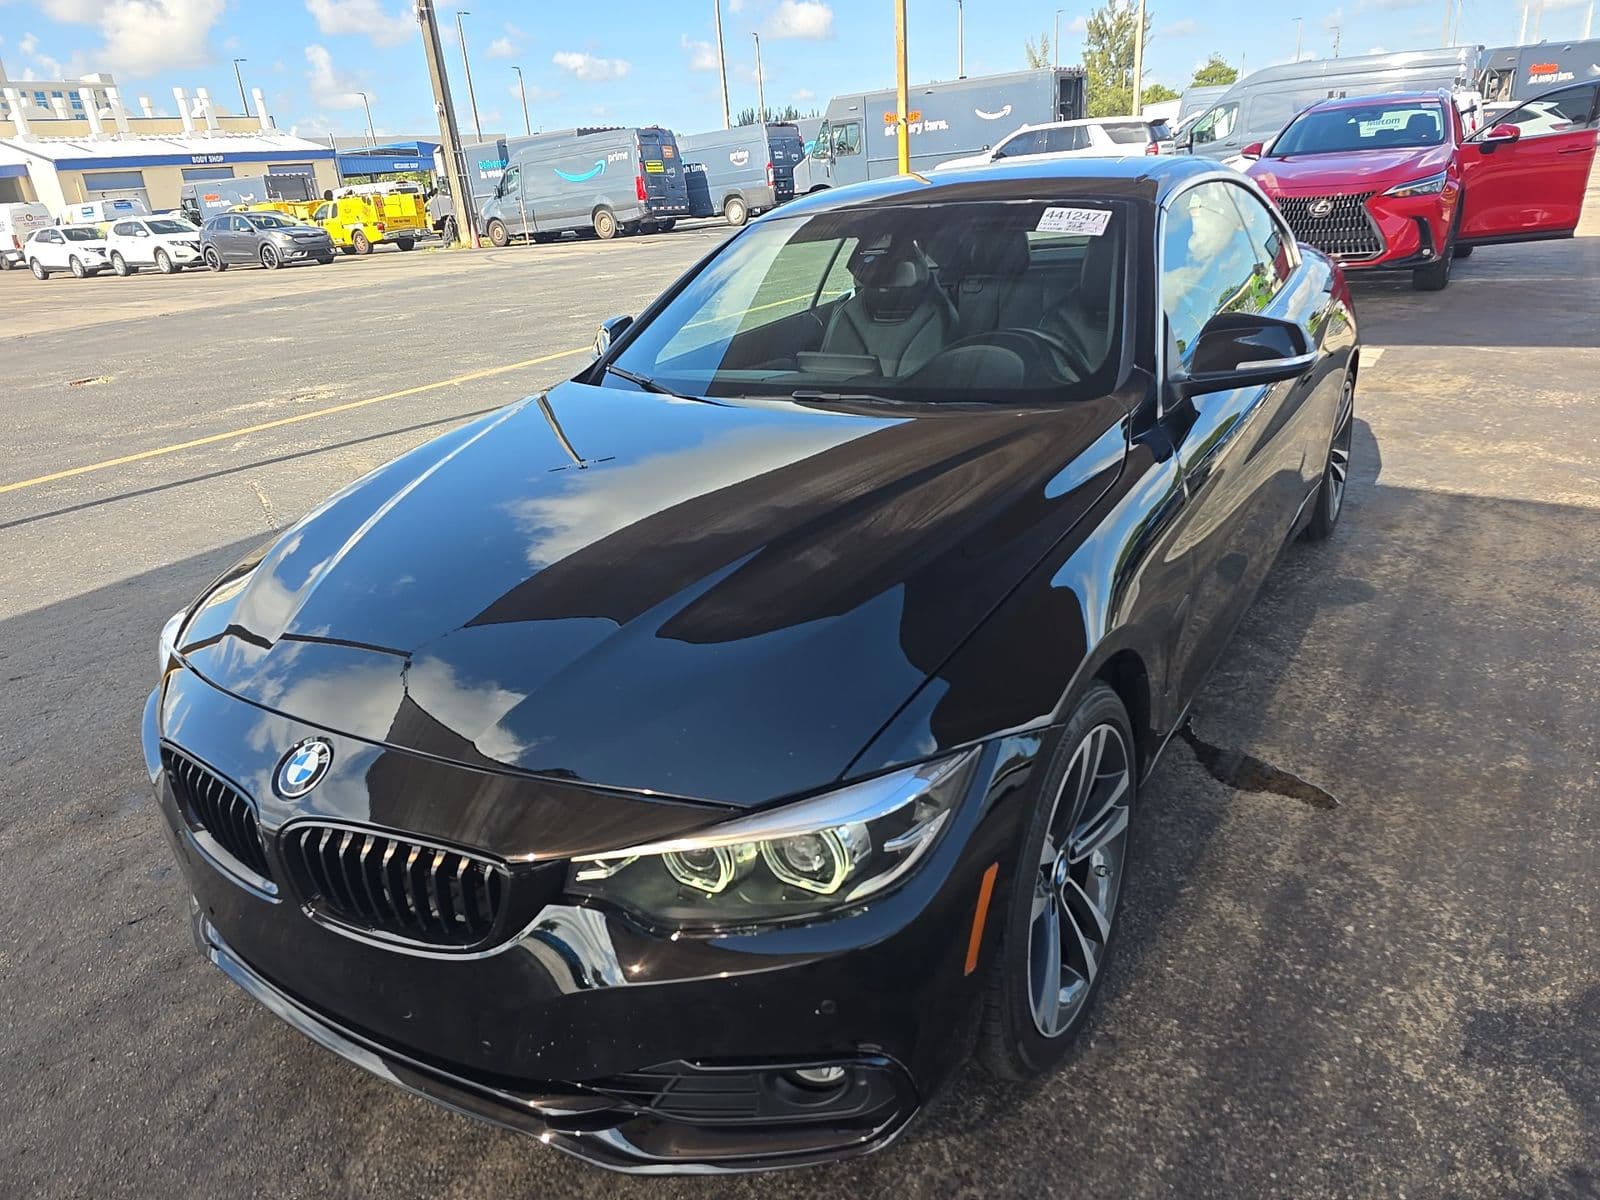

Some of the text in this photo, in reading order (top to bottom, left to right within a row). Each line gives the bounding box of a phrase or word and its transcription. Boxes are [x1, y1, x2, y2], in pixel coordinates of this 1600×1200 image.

[191, 155, 224, 164] BODY SHOP
[608, 151, 629, 164] prime
[1045, 210, 1109, 224] 4412471
